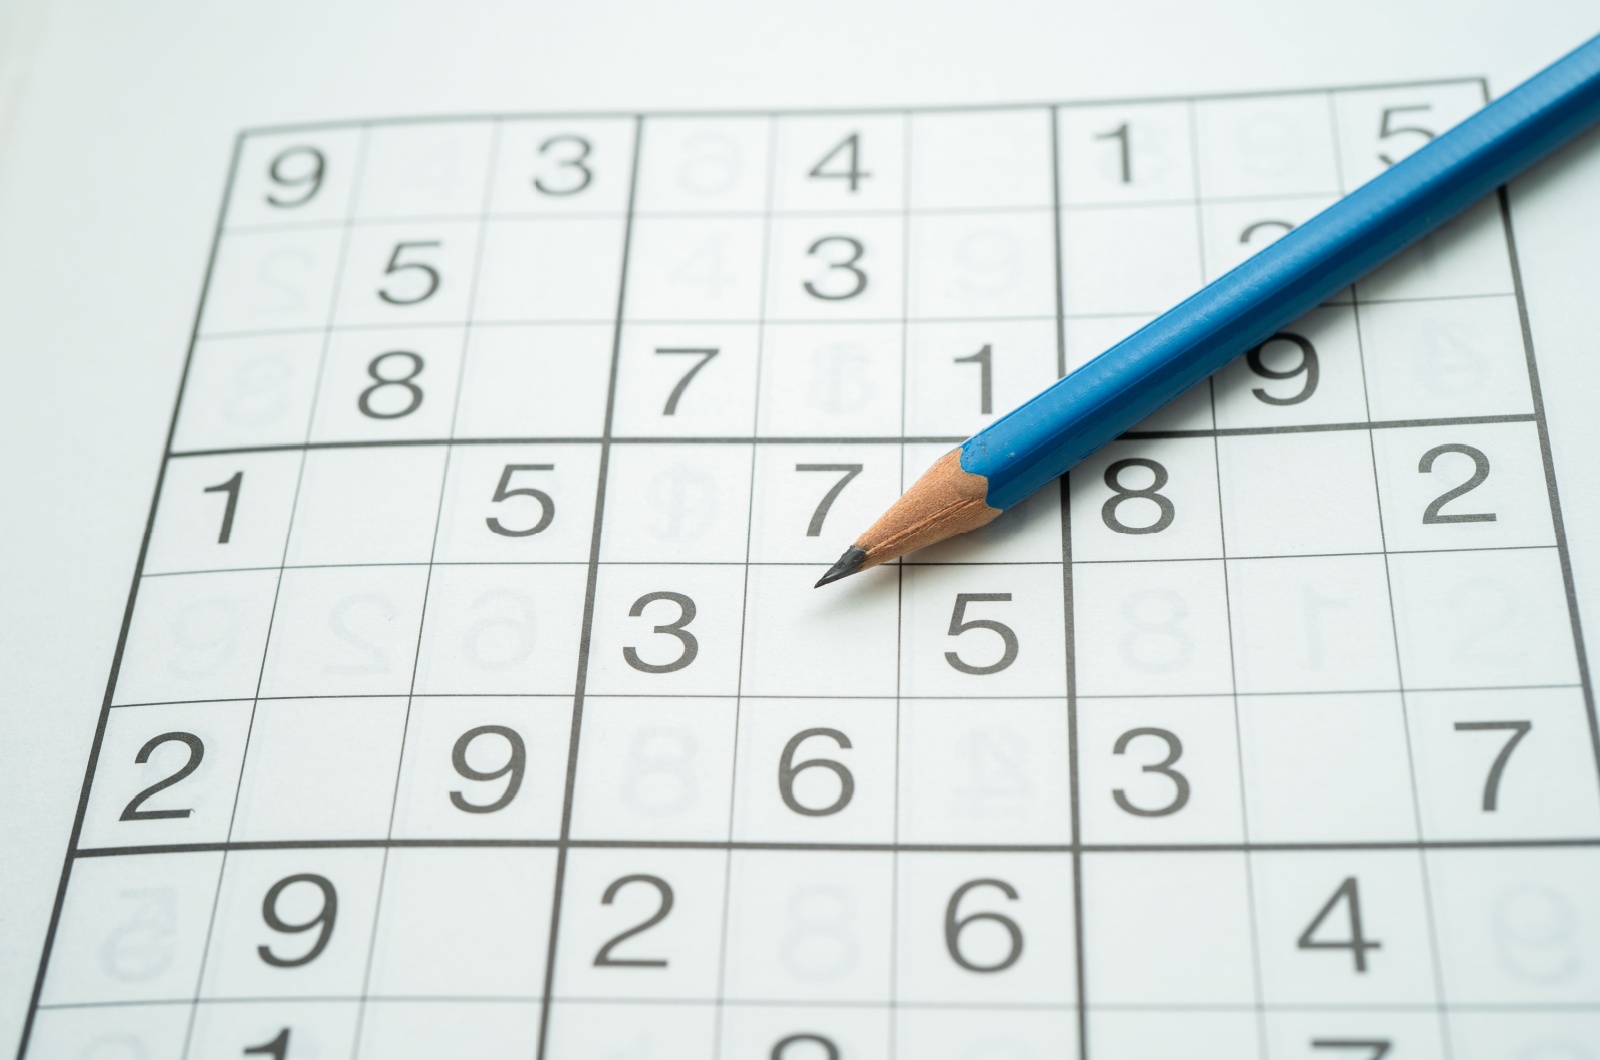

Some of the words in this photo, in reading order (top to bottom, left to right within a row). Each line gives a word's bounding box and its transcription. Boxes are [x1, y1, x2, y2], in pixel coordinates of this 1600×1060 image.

[264, 144, 327, 208] 9
[532, 136, 594, 196] 3
[807, 132, 871, 193] 4
[1094, 122, 1132, 184] 1
[377, 241, 441, 305] 5
[802, 235, 868, 302] 3
[358, 350, 424, 421] 8
[654, 346, 720, 416] 7
[953, 344, 993, 415] 1
[1245, 331, 1320, 406] 9
[203, 471, 244, 545] 1
[485, 464, 556, 538] 5
[795, 463, 864, 537] 7
[1101, 458, 1176, 535] 8
[1417, 443, 1498, 524] 2
[622, 591, 699, 675] 3
[944, 592, 1020, 675] 5
[119, 731, 203, 820] 2
[449, 724, 527, 815] 9
[777, 727, 856, 818] 6
[1111, 727, 1191, 818] 3
[1453, 720, 1533, 813] 7
[256, 872, 339, 969] 9
[592, 873, 675, 969] 2
[943, 877, 1025, 975] 6
[1295, 876, 1384, 974] 4
